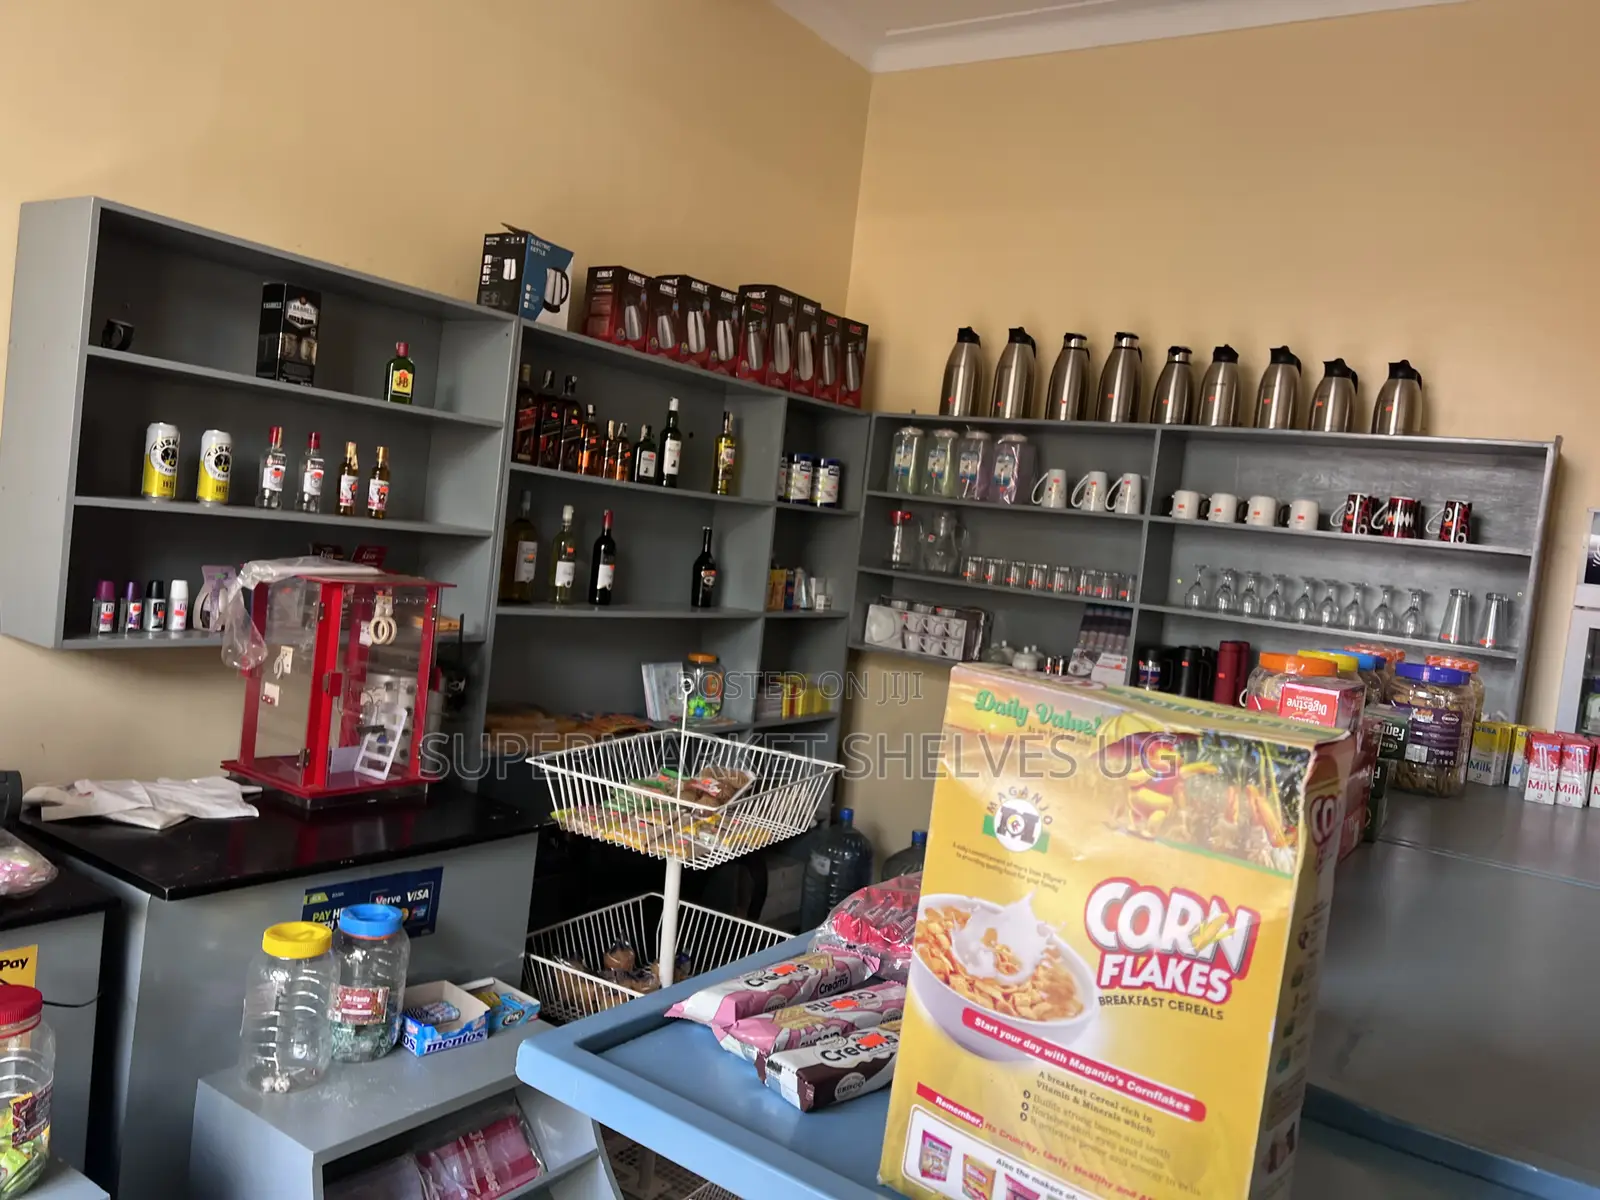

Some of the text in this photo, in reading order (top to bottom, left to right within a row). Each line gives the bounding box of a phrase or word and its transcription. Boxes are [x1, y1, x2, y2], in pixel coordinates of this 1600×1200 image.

[975, 688, 1028, 727] Daily
[1034, 702, 1103, 737] Value!
[1286, 697, 1328, 716] Digestive
[1468, 760, 1492, 773] Milk
[1527, 779, 1555, 793] Milk
[1556, 782, 1583, 796] Milk
[986, 785, 1053, 825] MAGANJO
[406, 888, 430, 903] VISA
[312, 910, 332, 922] PAY
[1085, 880, 1252, 974] CORN
[818, 975, 849, 995] Creams
[1099, 952, 1232, 1004] FLAKES
[1098, 995, 1224, 1020] BREAKFAST CEREALS
[426, 1029, 485, 1052] mentos
[975, 1016, 1191, 1114] Start your day with Maganjo's Cornflakes
[1036, 1081, 1071, 1102] Vitamin
[1072, 1096, 1080, 1105] &
[1082, 1099, 1122, 1123] Minerals
[1038, 1071, 1045, 1079] A
[1047, 1074, 1087, 1096] breakfast
[1090, 1091, 1119, 1110] Cereal
[1120, 1102, 1140, 1118] rich
[935, 1095, 984, 1129] Remember,
[996, 1158, 1015, 1173] Also
[1016, 1167, 1030, 1180] the
[1031, 1176, 1064, 1196] makers
